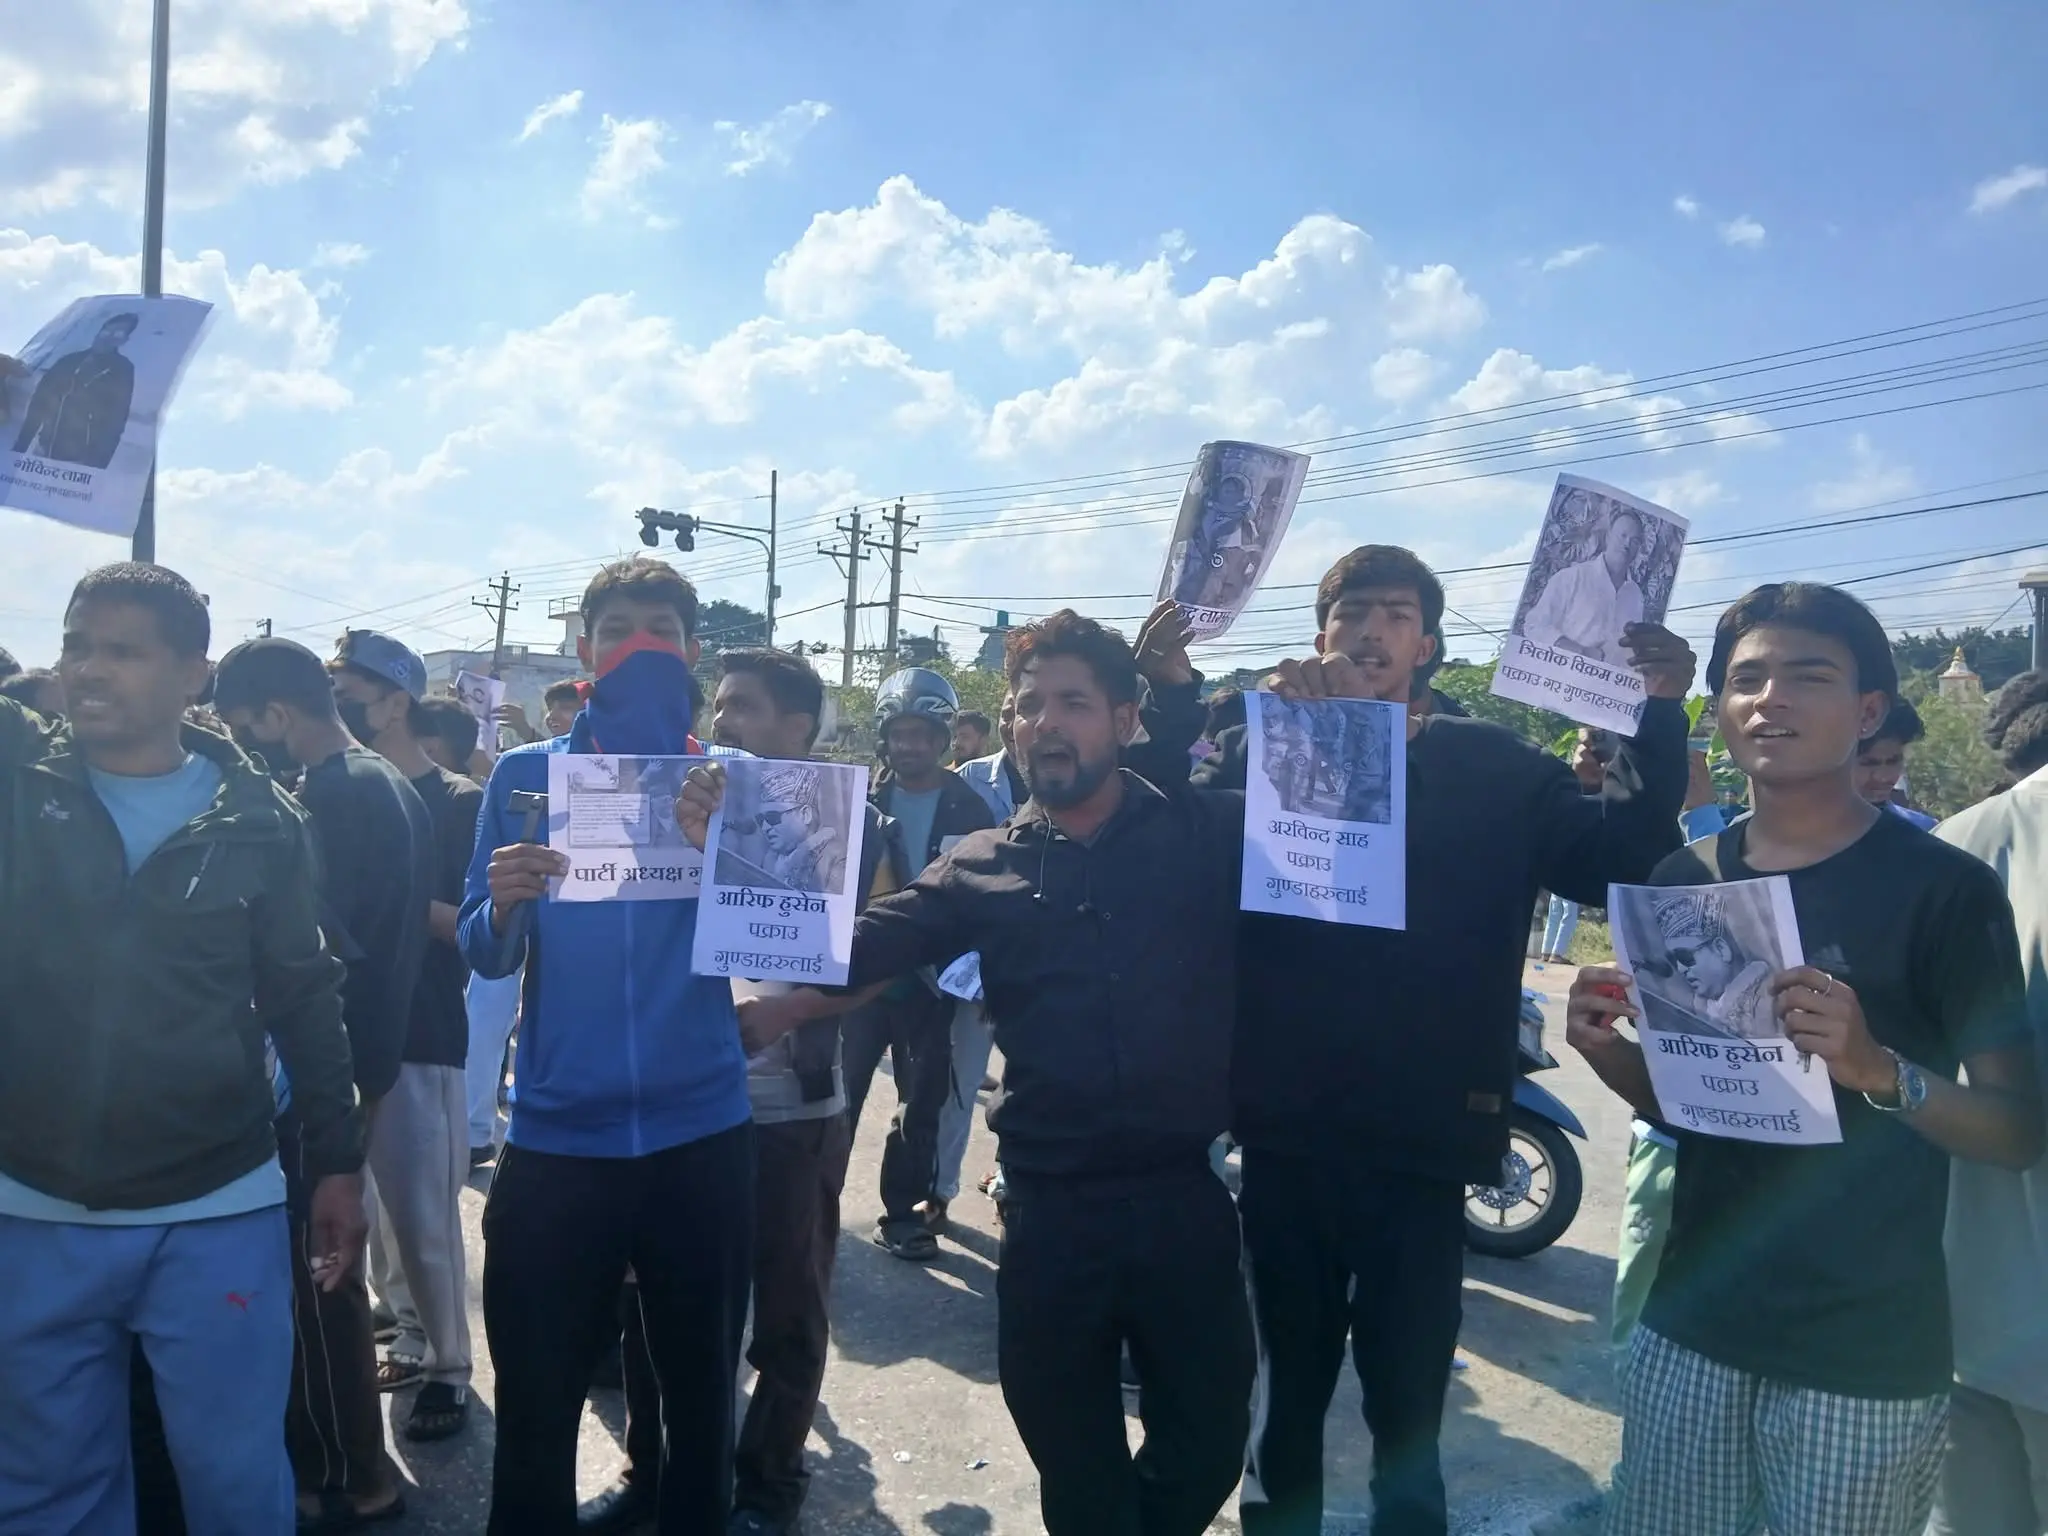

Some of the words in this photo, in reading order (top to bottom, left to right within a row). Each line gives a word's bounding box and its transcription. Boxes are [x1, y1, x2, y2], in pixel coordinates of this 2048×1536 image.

[62, 470, 92, 485] लामा
[1502, 665, 1543, 686] पक्राउ
[1543, 677, 1562, 693] गर
[1614, 673, 1642, 693] शाह
[1268, 820, 1331, 844] अरविन्द
[1335, 831, 1370, 848] साह
[574, 862, 619, 881] पार्टी
[621, 867, 684, 883] अध्यक्ष
[1286, 851, 1332, 872] पक्राउ
[716, 887, 776, 908] आरिफ
[777, 892, 829, 917] हुसेन
[1266, 877, 1369, 906] गुण्डाहरुलाई
[748, 922, 801, 941] पक्राउ
[714, 950, 824, 975] गुण्डाहरुलाई
[1658, 1035, 1720, 1060] आरिफ
[1722, 1040, 1784, 1070] हुसेन
[1701, 1075, 1759, 1096] पक्राउ
